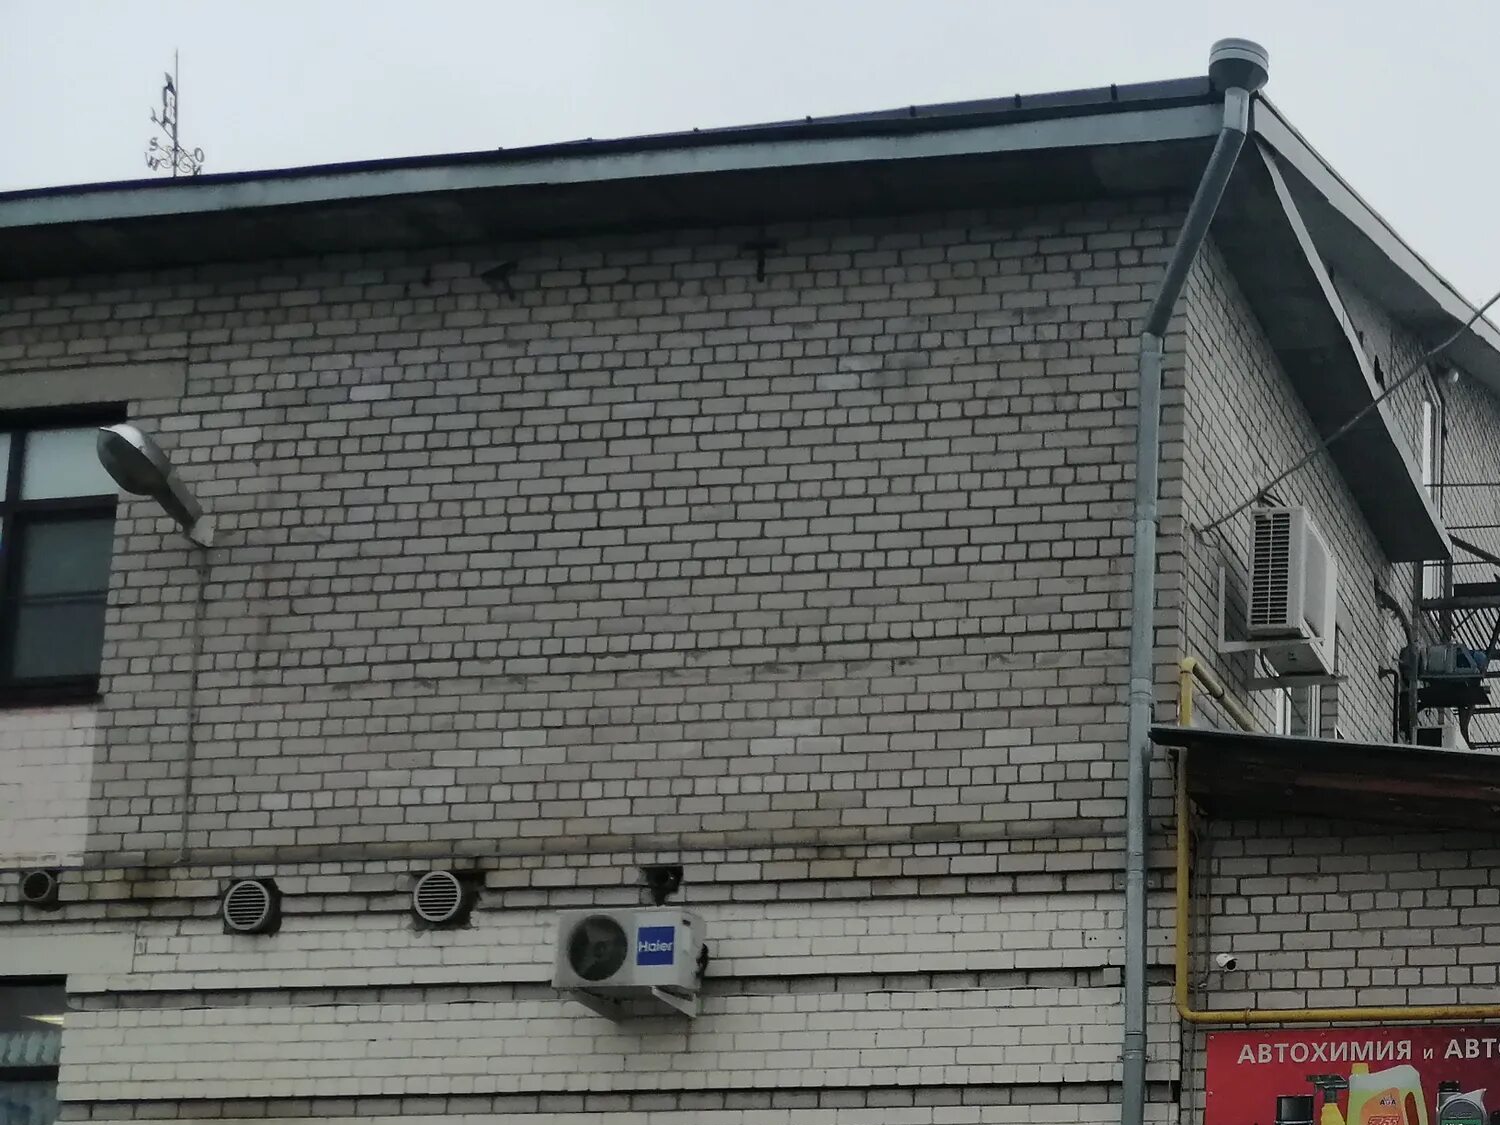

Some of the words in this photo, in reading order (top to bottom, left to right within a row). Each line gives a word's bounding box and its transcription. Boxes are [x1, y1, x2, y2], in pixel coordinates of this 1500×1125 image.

[638, 939, 673, 953] Haier
[1237, 1039, 1412, 1064] АВТОХИМИЯ
[1423, 1047, 1434, 1060] и
